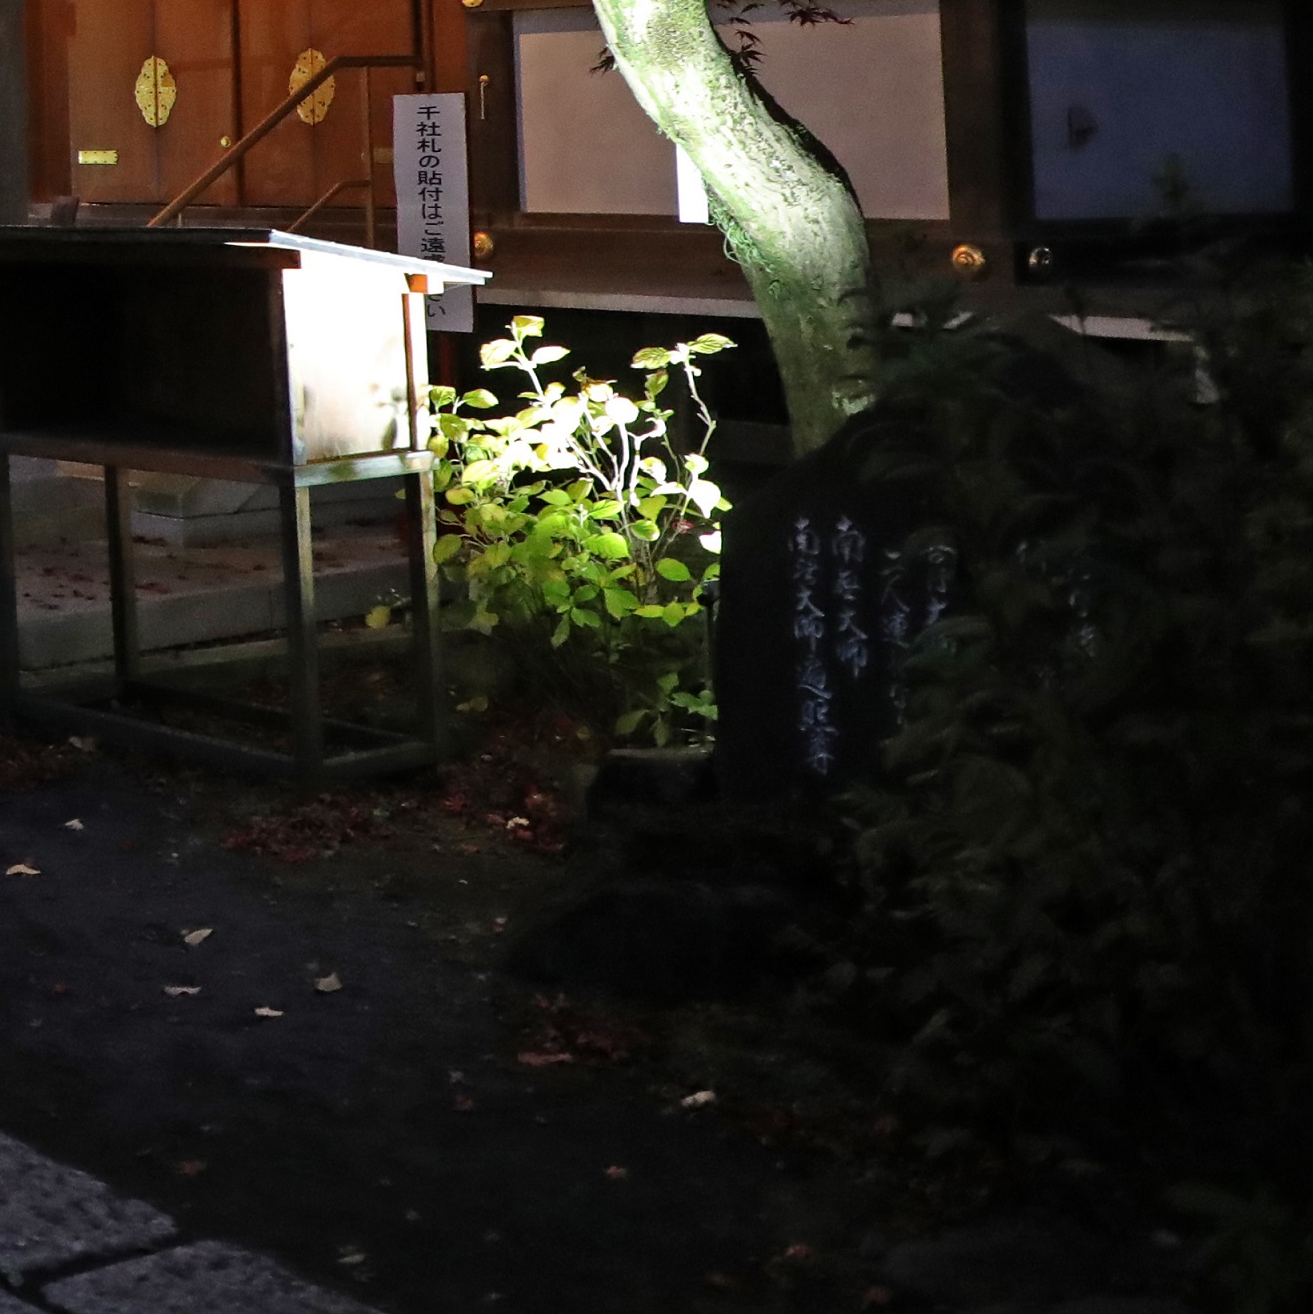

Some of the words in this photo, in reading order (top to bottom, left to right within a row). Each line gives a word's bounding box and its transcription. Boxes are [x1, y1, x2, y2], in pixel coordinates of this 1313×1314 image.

[416, 105, 447, 318] 千社札の貼付はご遠い
